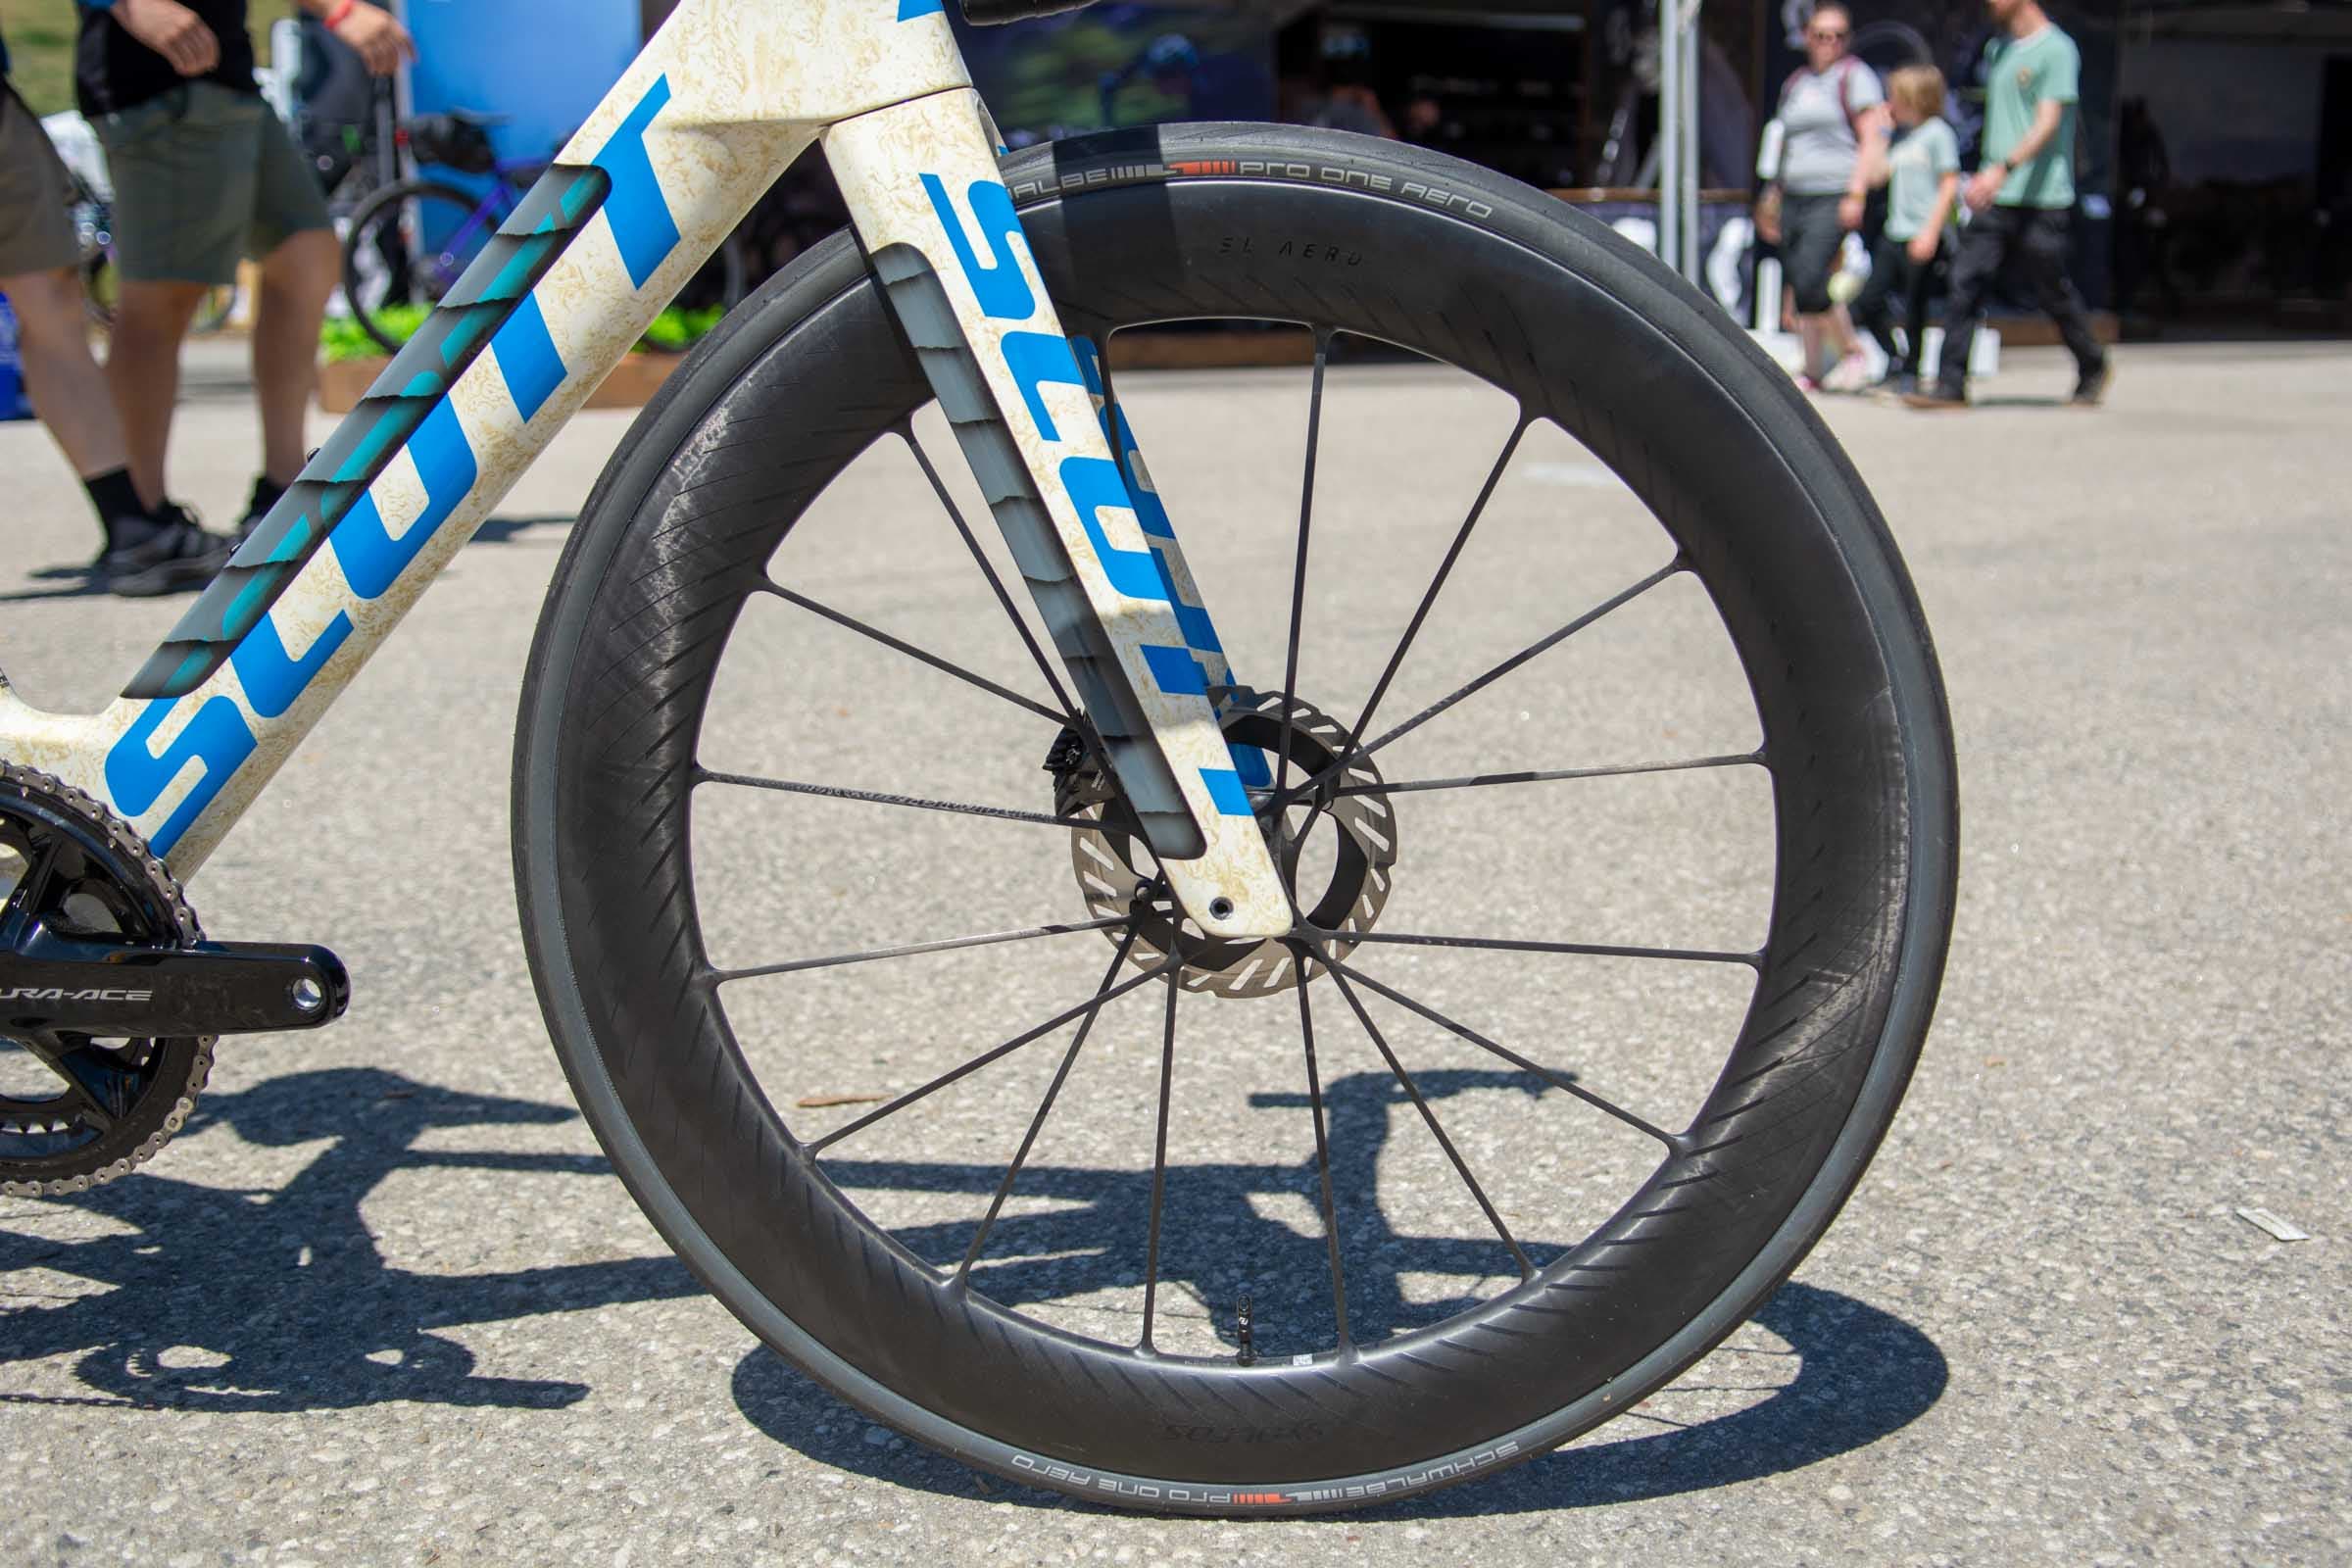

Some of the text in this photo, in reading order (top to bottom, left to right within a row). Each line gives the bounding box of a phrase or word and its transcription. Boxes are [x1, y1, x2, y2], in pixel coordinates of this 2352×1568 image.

[1006, 168, 1107, 199] ALBE
[105, 73, 681, 858] SCOTT
[1346, 1442, 1518, 1497] SCHWALBE
